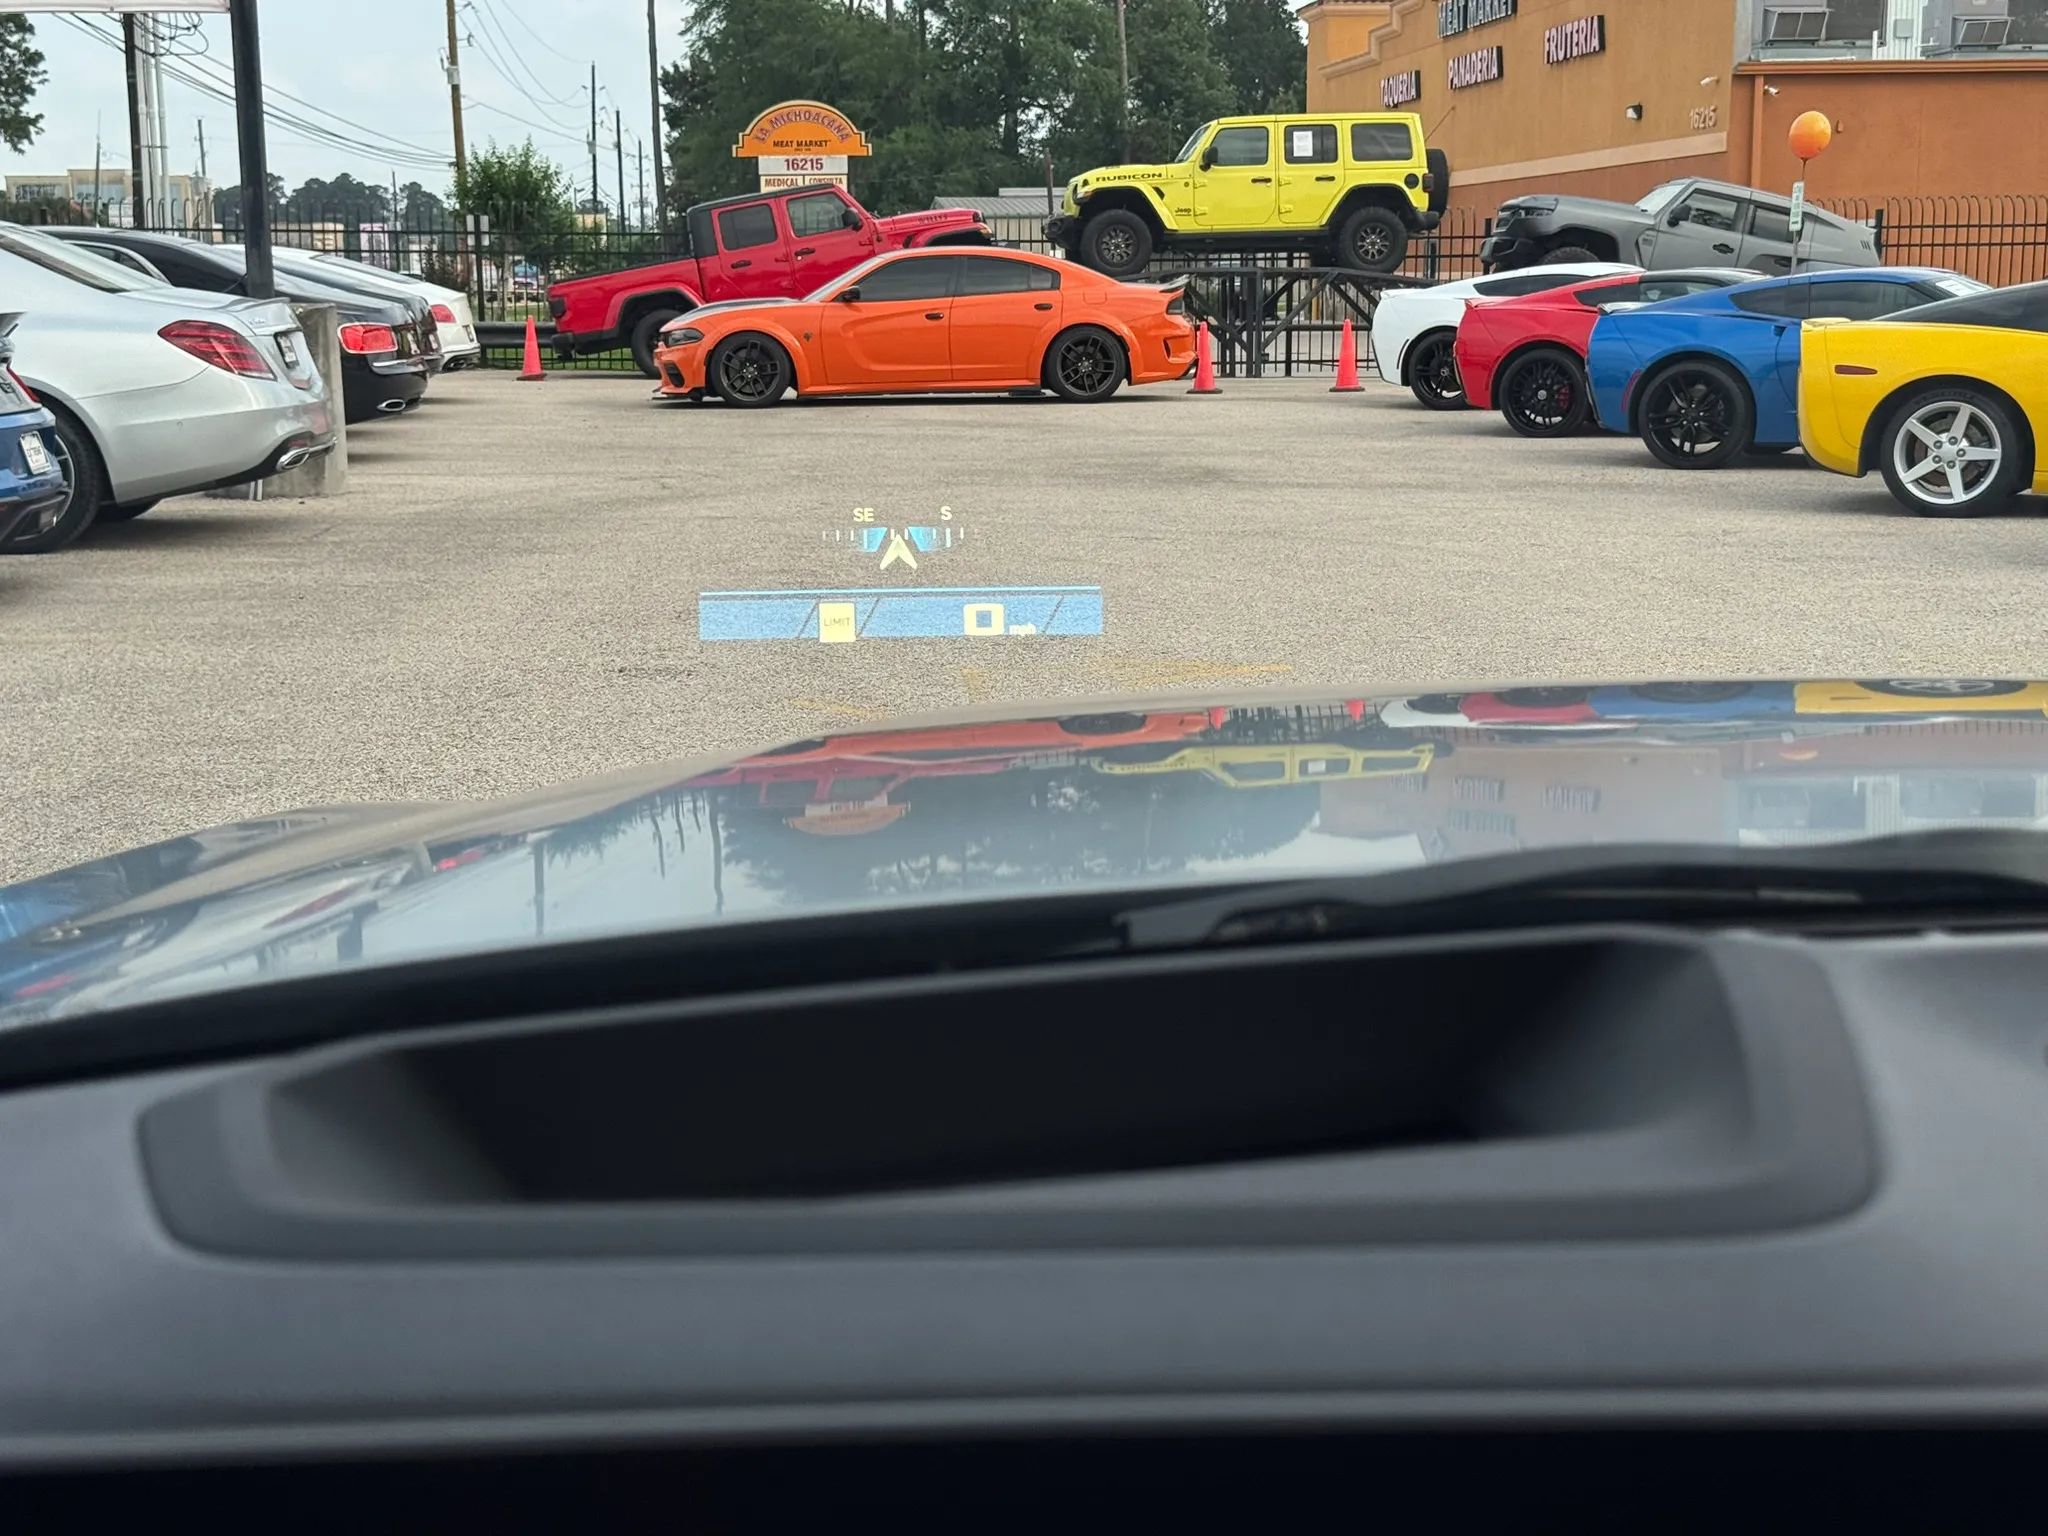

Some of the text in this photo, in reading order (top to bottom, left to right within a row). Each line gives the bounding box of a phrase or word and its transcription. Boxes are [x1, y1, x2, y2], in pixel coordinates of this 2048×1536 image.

[1437, 0, 1464, 39] MEAT
[1543, 15, 1600, 65] FRUTERIA
[1447, 45, 1499, 90] PANADERIA
[1380, 70, 1417, 108] TAQUERIA
[754, 109, 851, 144] LA MICHOACANA
[1689, 105, 1717, 129] 16215
[773, 139, 829, 148] MEAT MARKET
[784, 158, 824, 171] 16215
[764, 175, 799, 188] MEDICAL
[1095, 173, 1162, 182] RUBICON
[852, 507, 875, 523] SE
[939, 505, 953, 521] S
[823, 616, 851, 628] LIMIT
[963, 602, 1005, 636] 0
